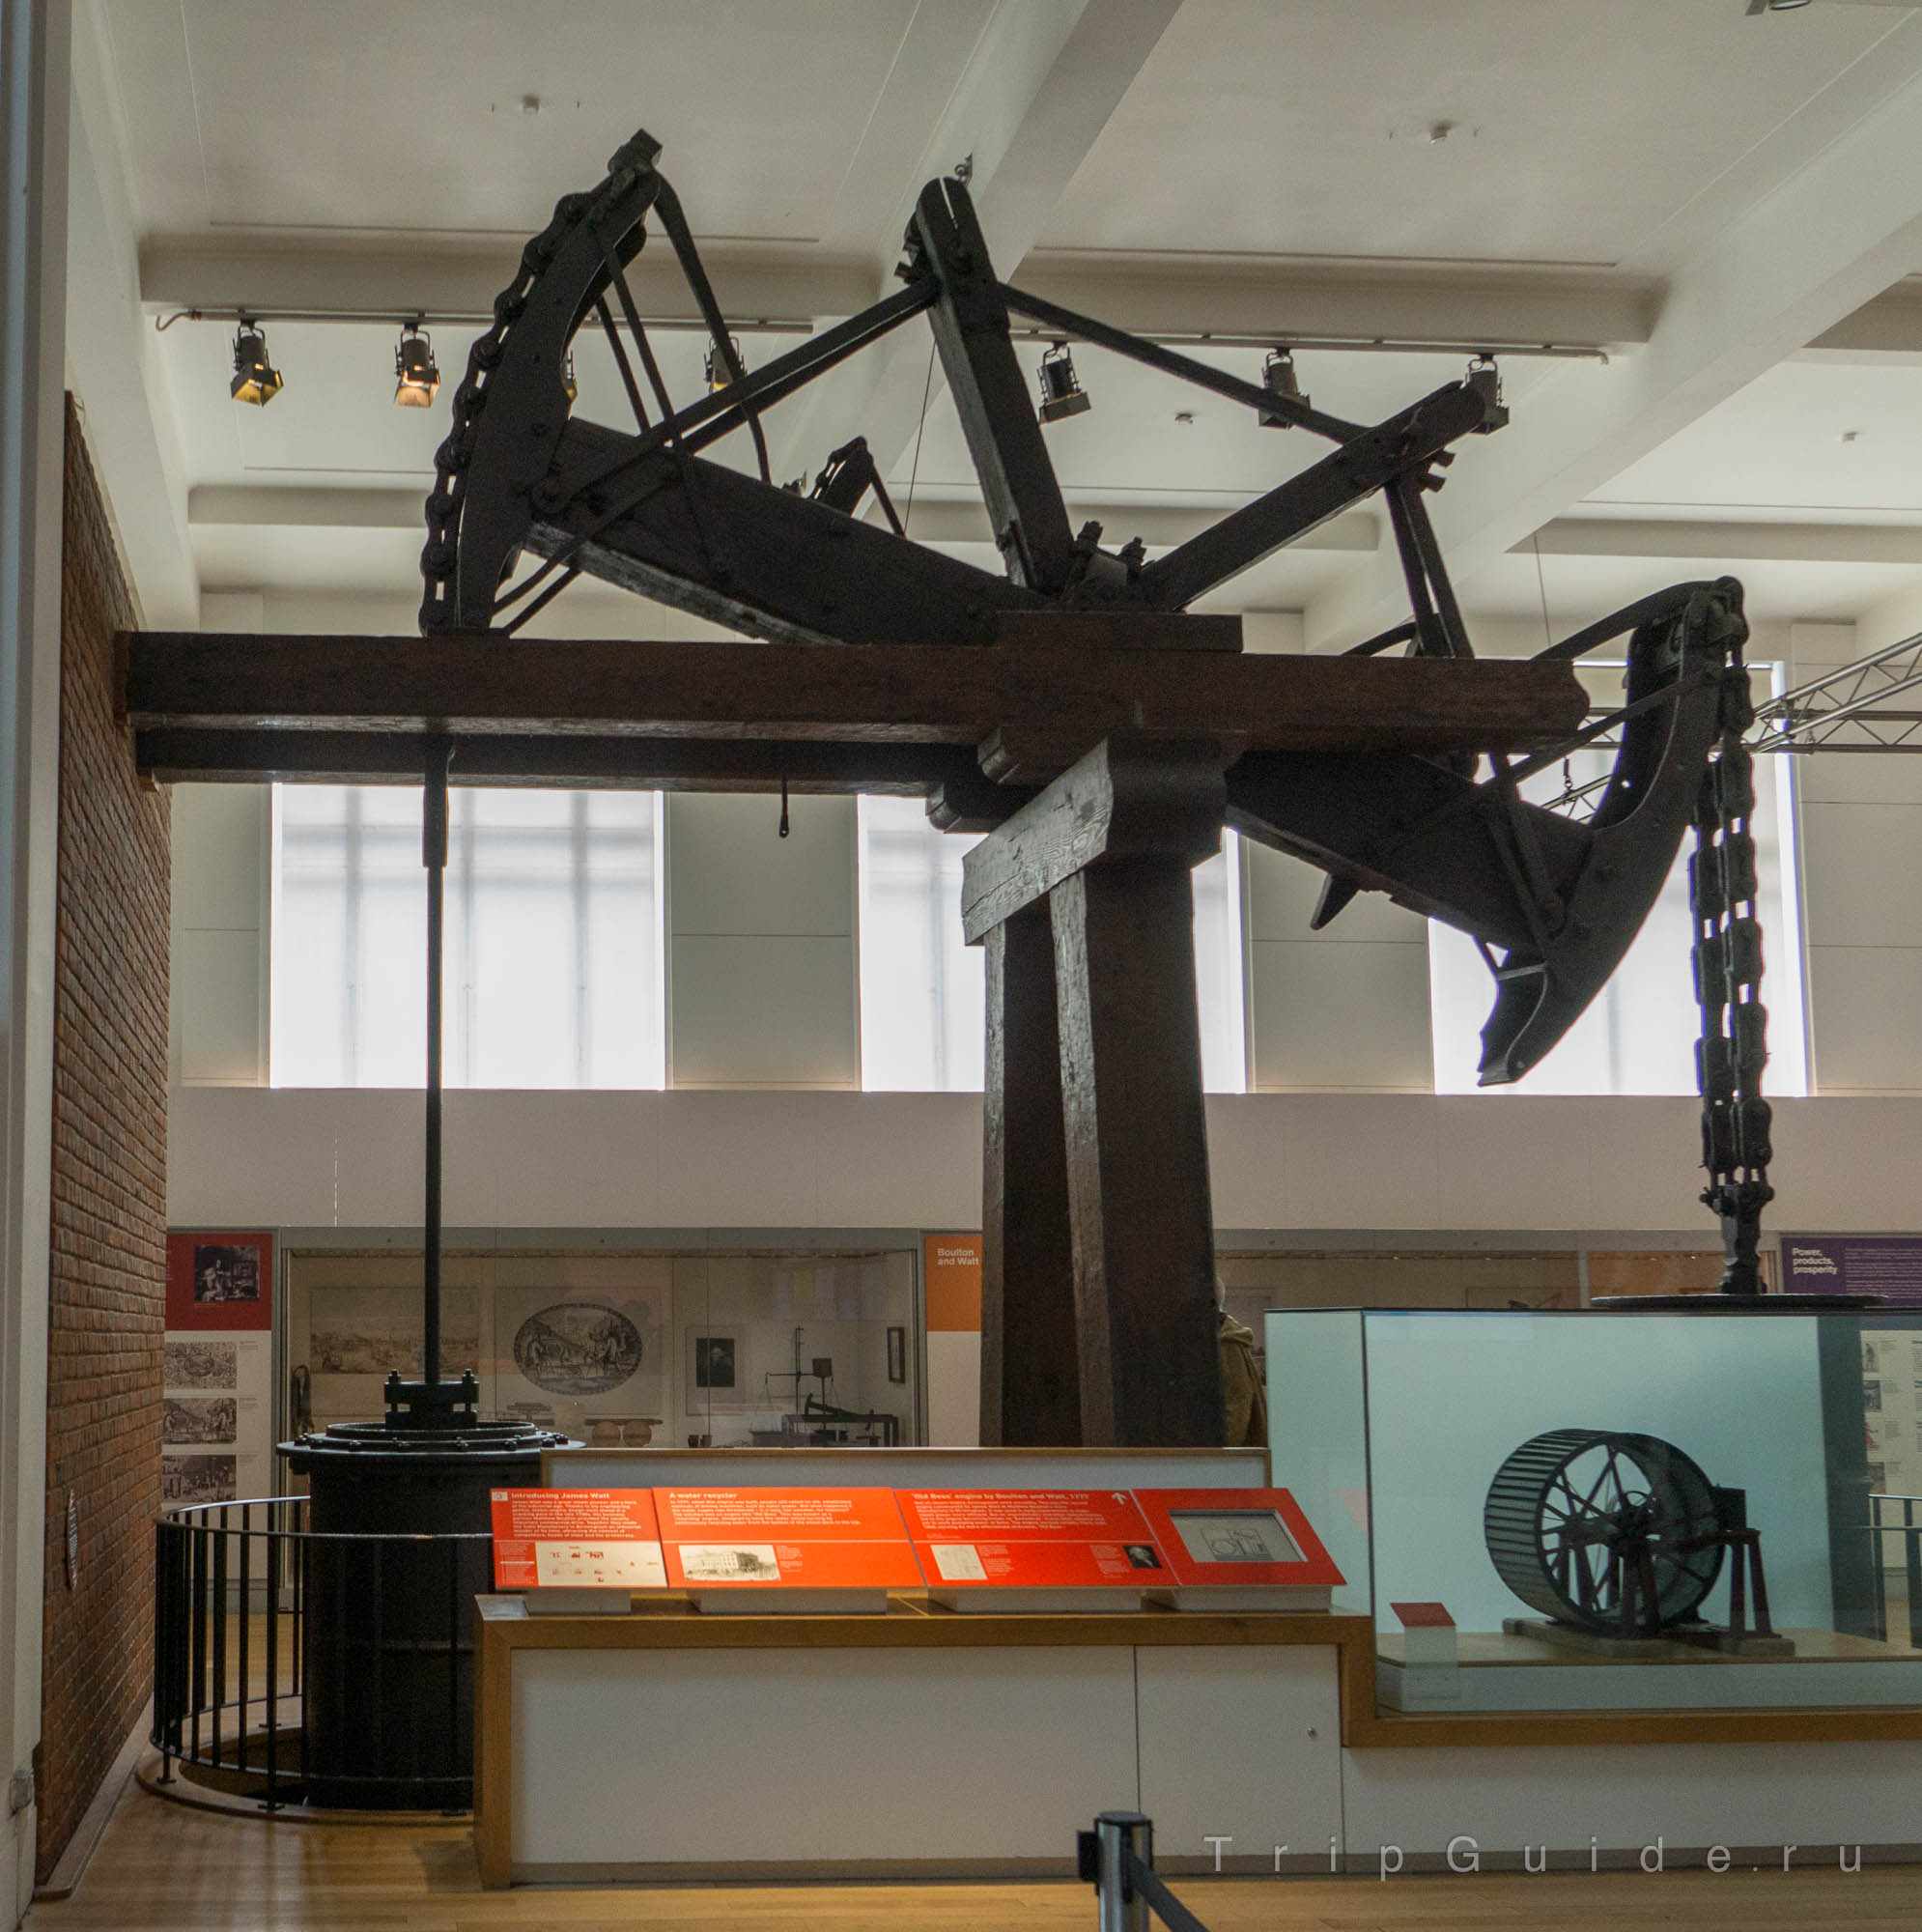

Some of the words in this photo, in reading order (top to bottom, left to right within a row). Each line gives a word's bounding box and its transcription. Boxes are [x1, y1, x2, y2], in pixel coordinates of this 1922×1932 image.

[937, 1248, 975, 1257] Boulton
[1792, 1247, 1823, 1257] Power,
[1793, 1257, 1835, 1265] products,
[1793, 1265, 1839, 1275] prosperity
[985, 1492, 995, 1501] by
